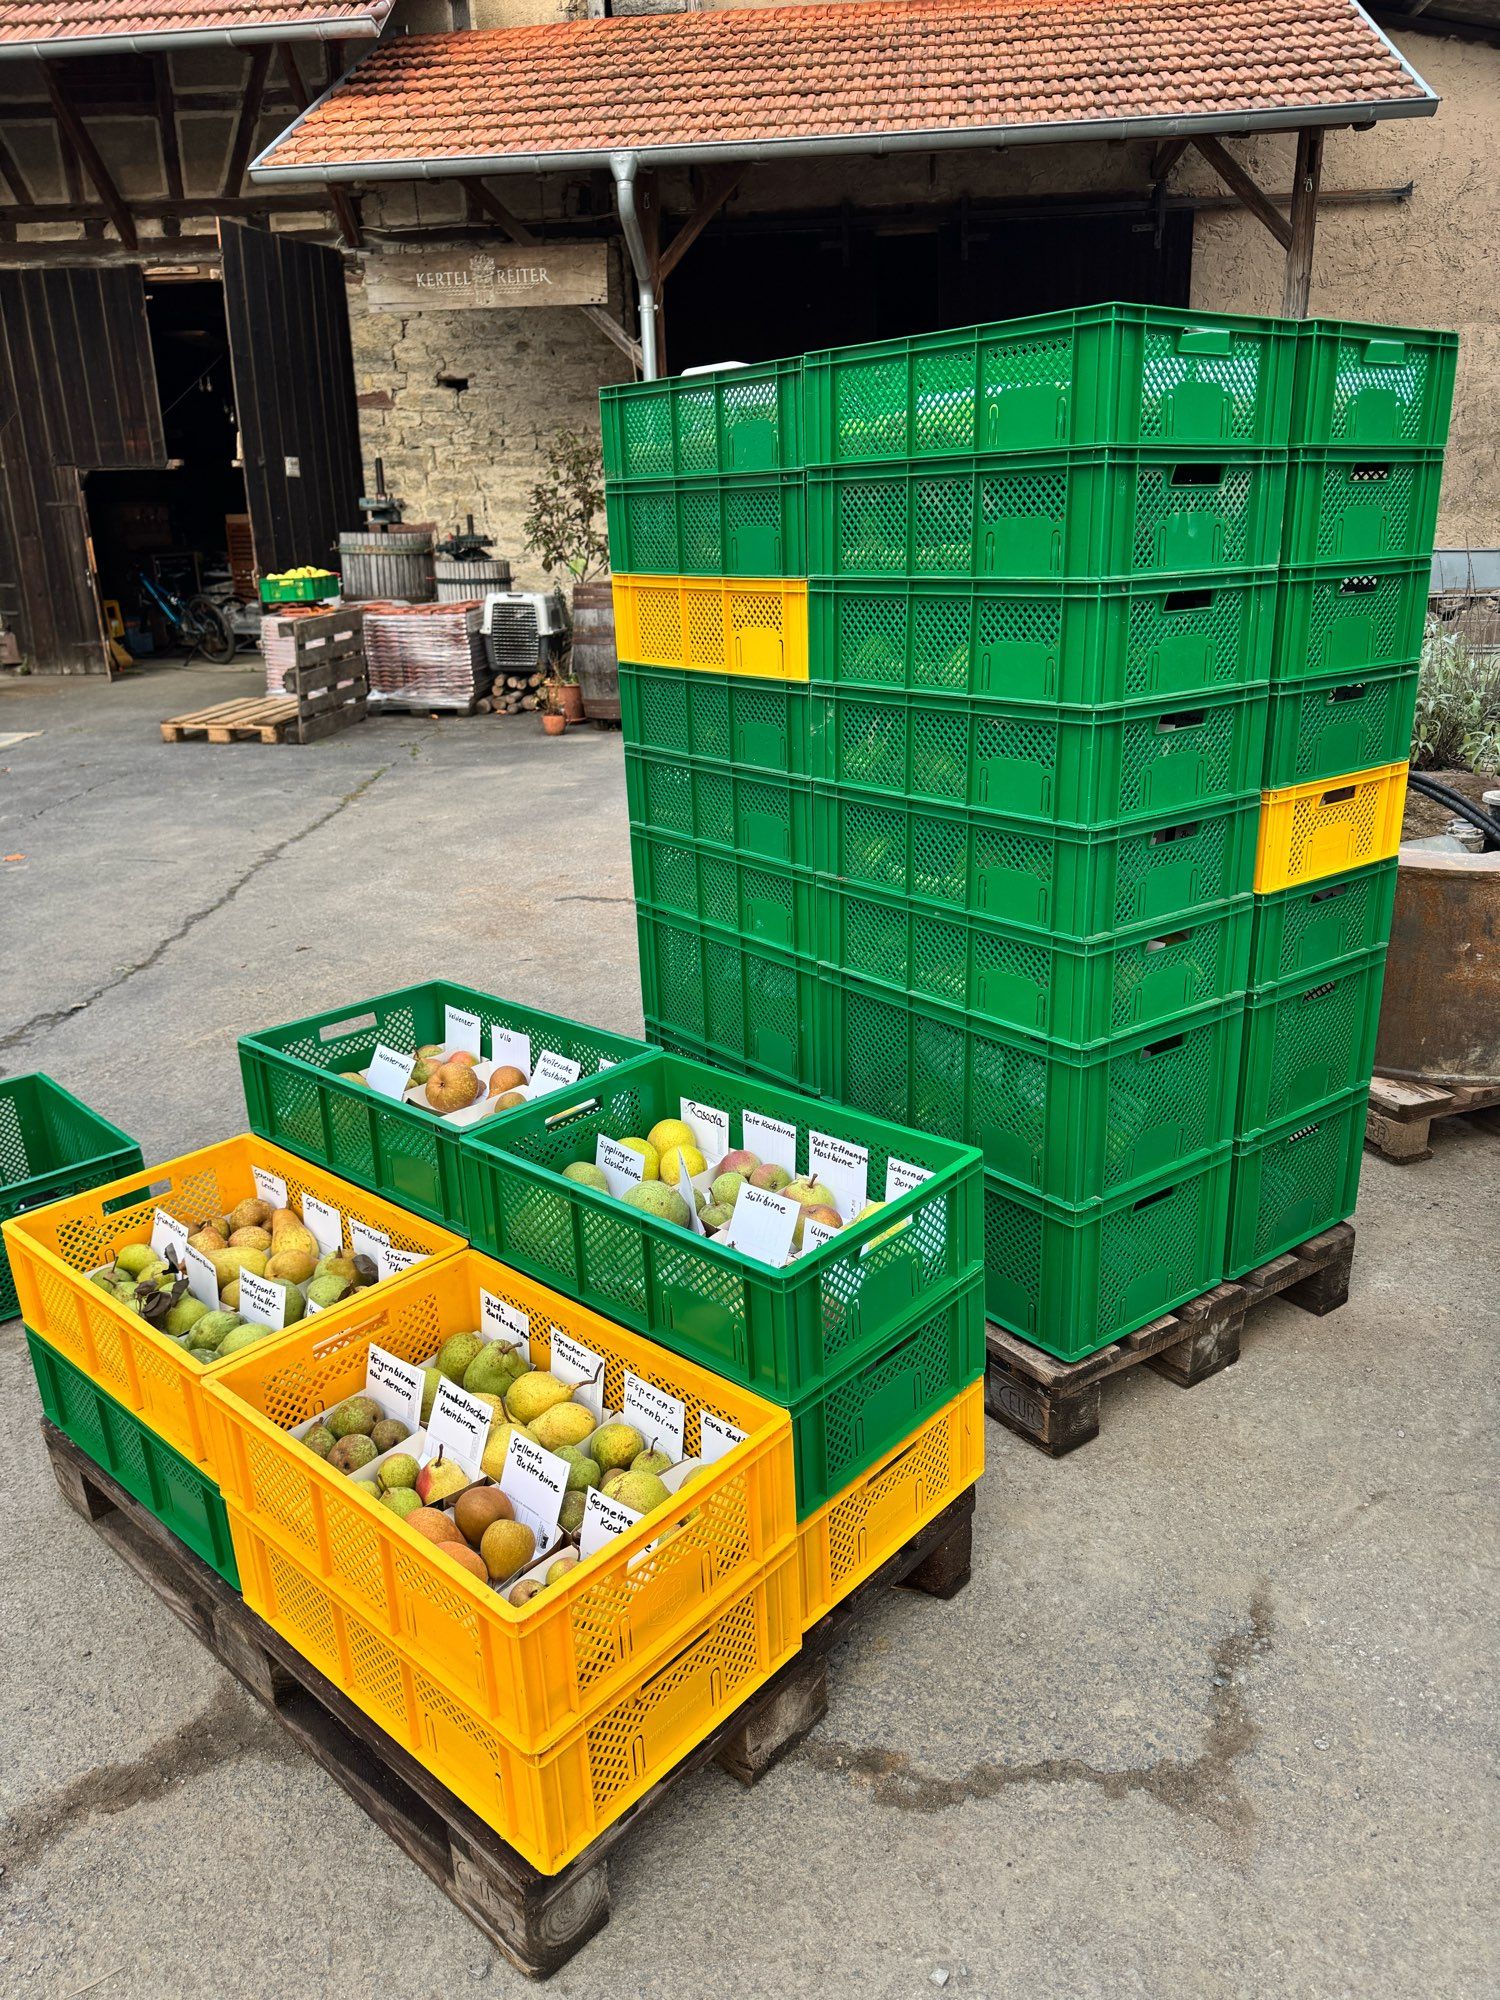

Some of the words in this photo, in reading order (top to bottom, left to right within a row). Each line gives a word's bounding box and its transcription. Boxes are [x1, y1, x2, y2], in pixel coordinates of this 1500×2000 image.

[415, 271, 472, 288] KERTEL
[496, 267, 553, 285] REITER
[745, 1113, 760, 1126] Rote
[761, 1119, 795, 1139] Kochbirne
[599, 1140, 635, 1164] Sipplinger
[811, 1135, 829, 1149] Rote
[603, 1156, 641, 1182] Klosterbirne
[813, 1147, 854, 1169] Mostbirne
[305, 1197, 329, 1216] Gorham
[382, 1250, 416, 1265] Grüne
[252, 1302, 271, 1317] birne
[484, 1296, 505, 1314] Diels
[553, 1332, 587, 1358] Egnacher
[369, 1369, 381, 1381] aus
[370, 1351, 417, 1390] Feigenbirne
[557, 1347, 593, 1378] Mostbirne
[438, 1384, 490, 1425] Frankelbacher
[627, 1376, 676, 1415] Esperens
[1009, 1390, 1037, 1426] EUR
[440, 1402, 478, 1435] Weinbirne
[626, 1393, 679, 1435] Herrenbirne
[704, 1416, 723, 1435] Eva
[510, 1437, 543, 1464] Gellerts
[516, 1454, 560, 1494] Butterbirne
[587, 1492, 634, 1528] Gemeine
